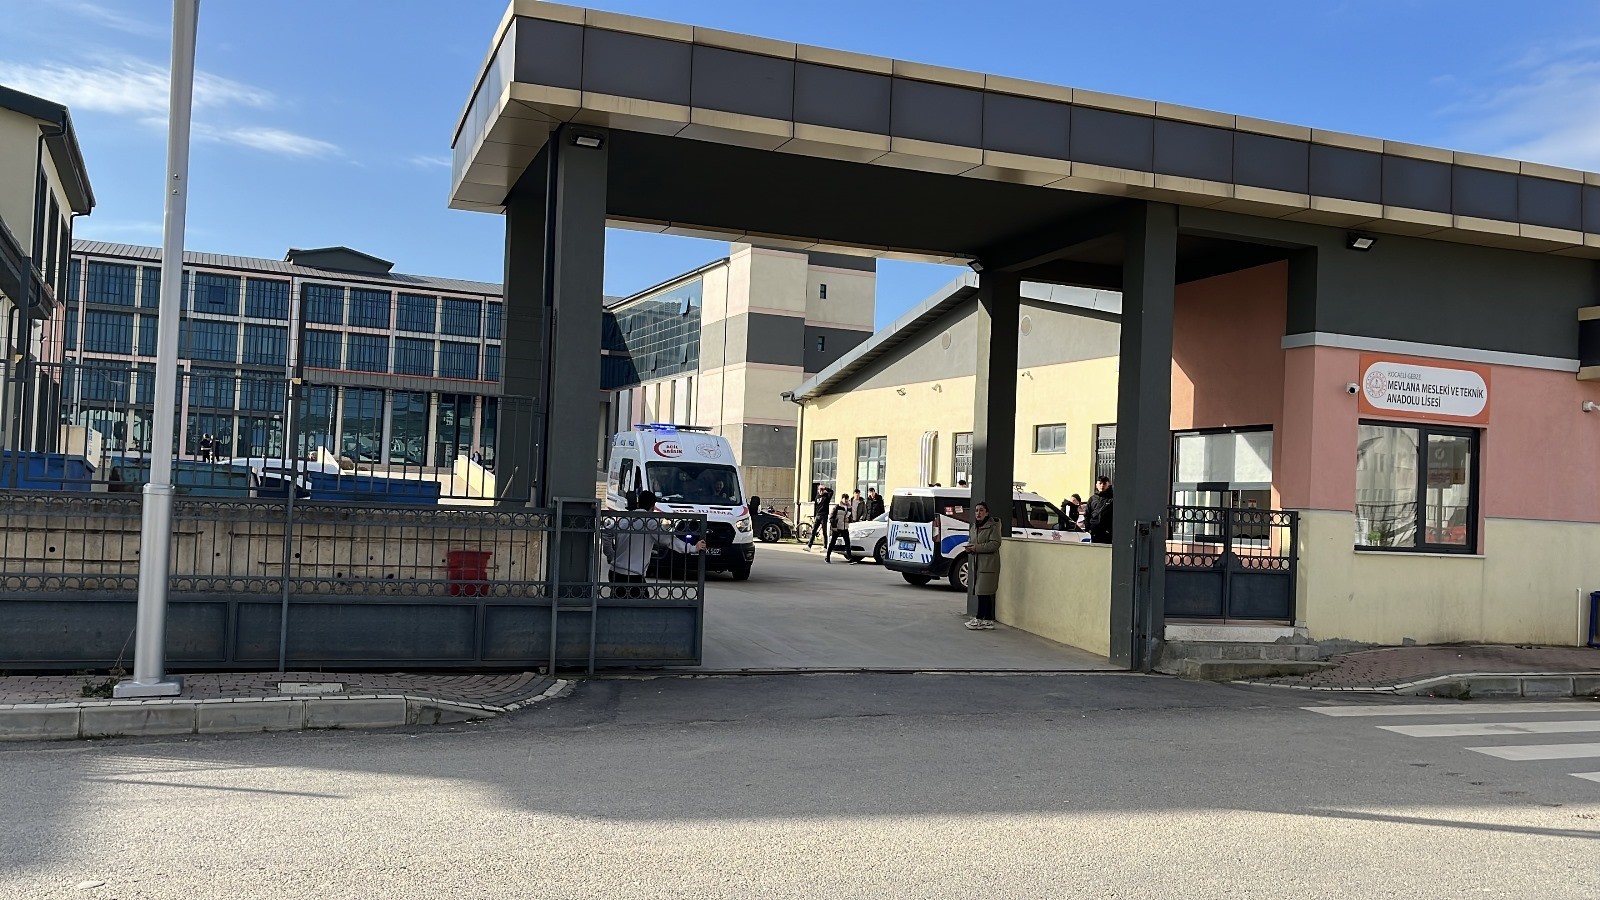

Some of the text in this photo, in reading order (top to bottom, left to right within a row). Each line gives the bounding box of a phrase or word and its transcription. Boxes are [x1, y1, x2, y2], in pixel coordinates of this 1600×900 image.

[1387, 380, 1484, 398] MEVLANA MESLEKİ VE TEKNİK
[1387, 393, 1441, 407] ANADOLU LİSESİ
